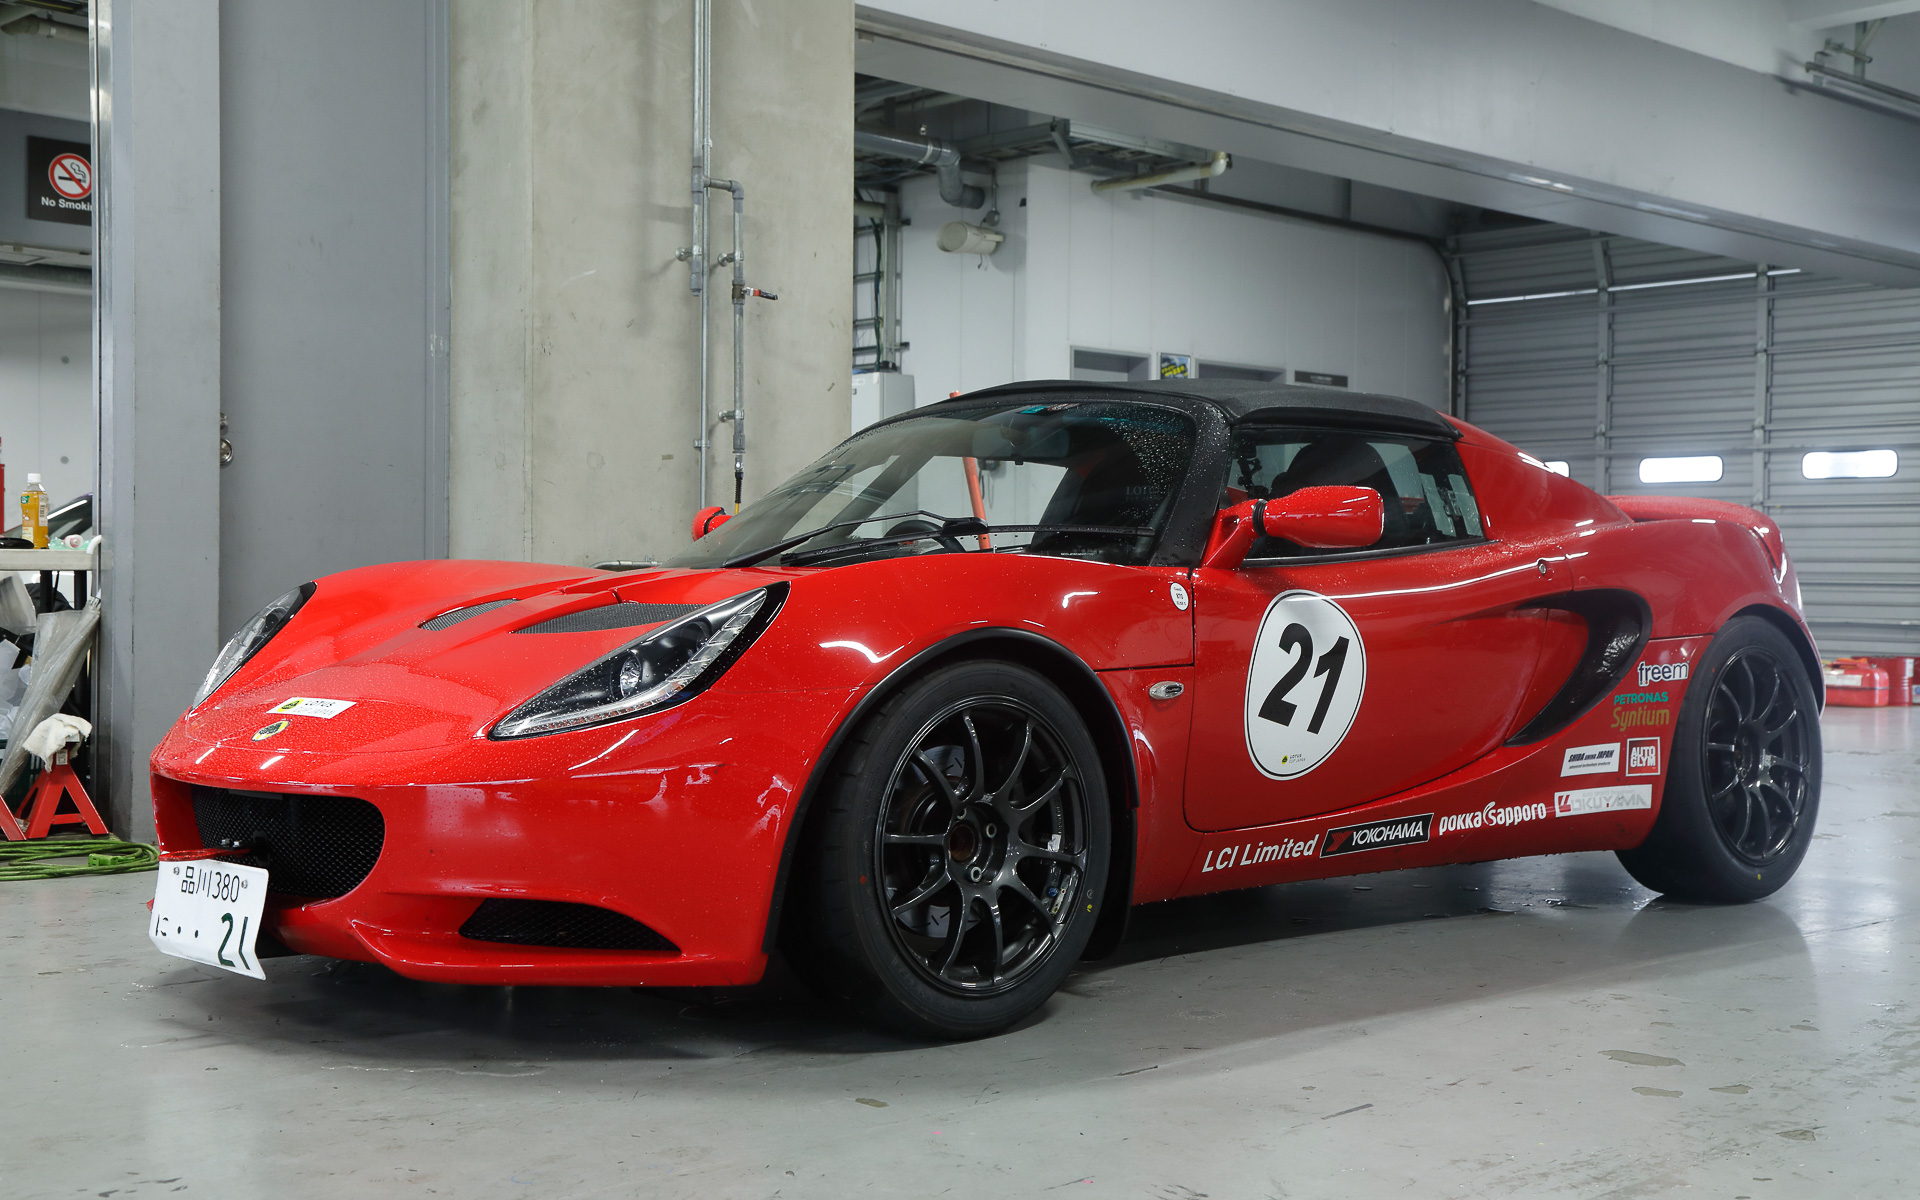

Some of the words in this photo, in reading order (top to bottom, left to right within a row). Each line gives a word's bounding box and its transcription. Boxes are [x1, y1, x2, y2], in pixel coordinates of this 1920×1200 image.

[41, 196, 56, 207] No
[1258, 622, 1350, 735] 21
[1638, 662, 1688, 685] freem
[1614, 691, 1669, 705] PETRONAS
[1611, 705, 1670, 732] Syntium
[1630, 756, 1656, 767] GLYM
[1631, 746, 1656, 759] AUTO
[1351, 820, 1424, 847] YOKOHAMA
[1201, 846, 1239, 873] LCI
[1239, 833, 1320, 866] Limited
[217, 912, 251, 970] 21
